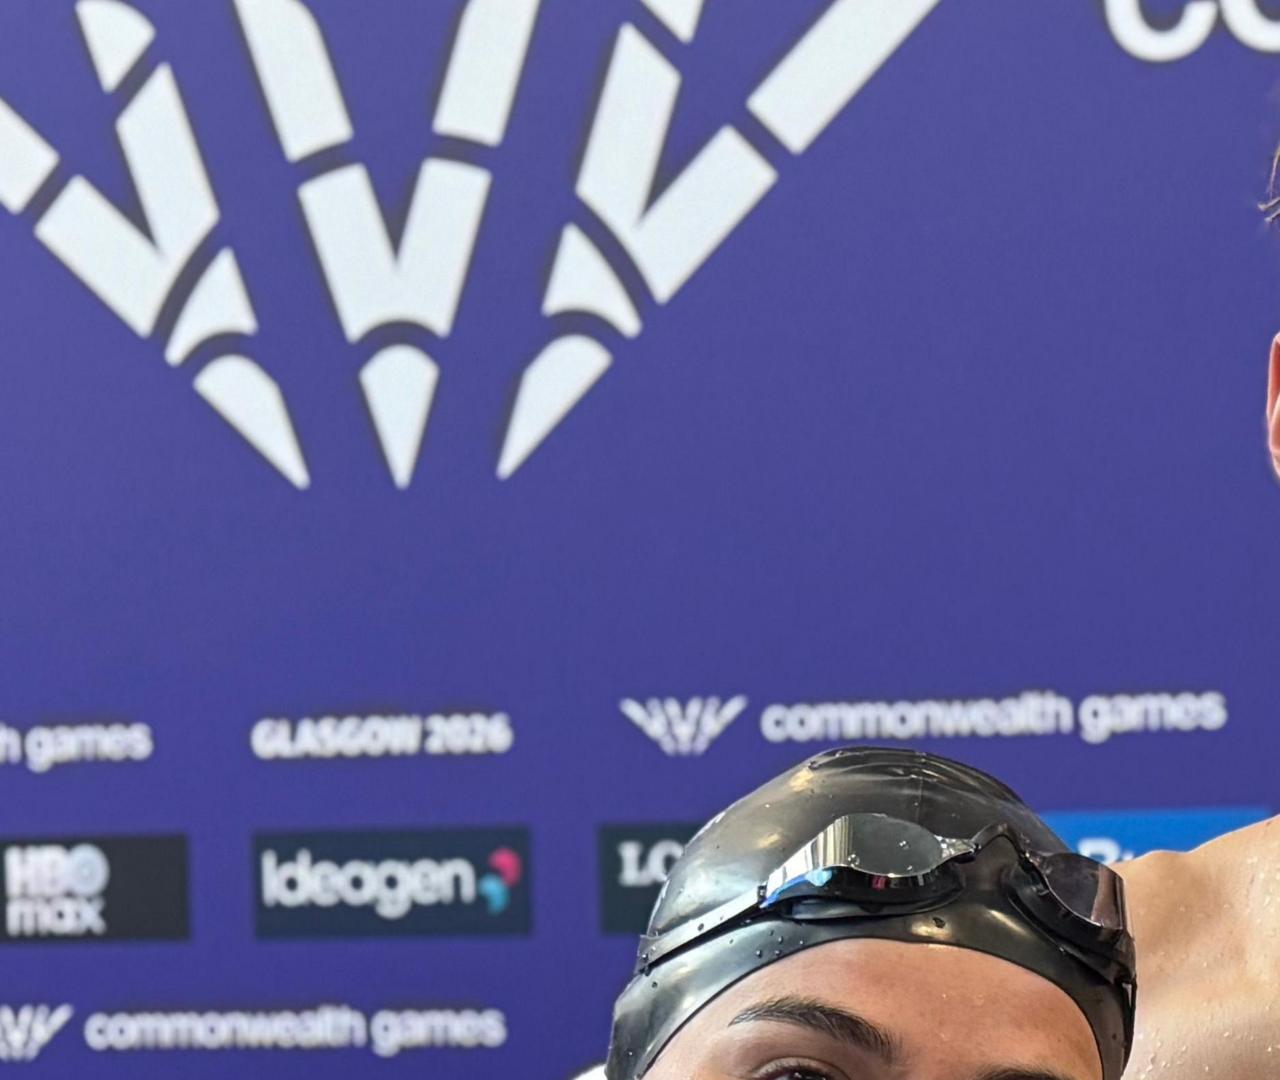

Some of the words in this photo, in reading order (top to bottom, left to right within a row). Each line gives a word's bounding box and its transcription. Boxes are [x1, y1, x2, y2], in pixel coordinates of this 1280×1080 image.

[250, 716, 424, 760] GLASGOW
[424, 711, 515, 755] 2026
[760, 692, 1073, 742] commonwealth
[1079, 690, 1228, 744] games
[24, 722, 154, 774] games
[4, 843, 110, 898] HBO
[260, 850, 477, 919] Ideagen
[6, 897, 107, 937] max
[85, 1006, 367, 1051] commonwealth
[370, 1007, 508, 1056] games
